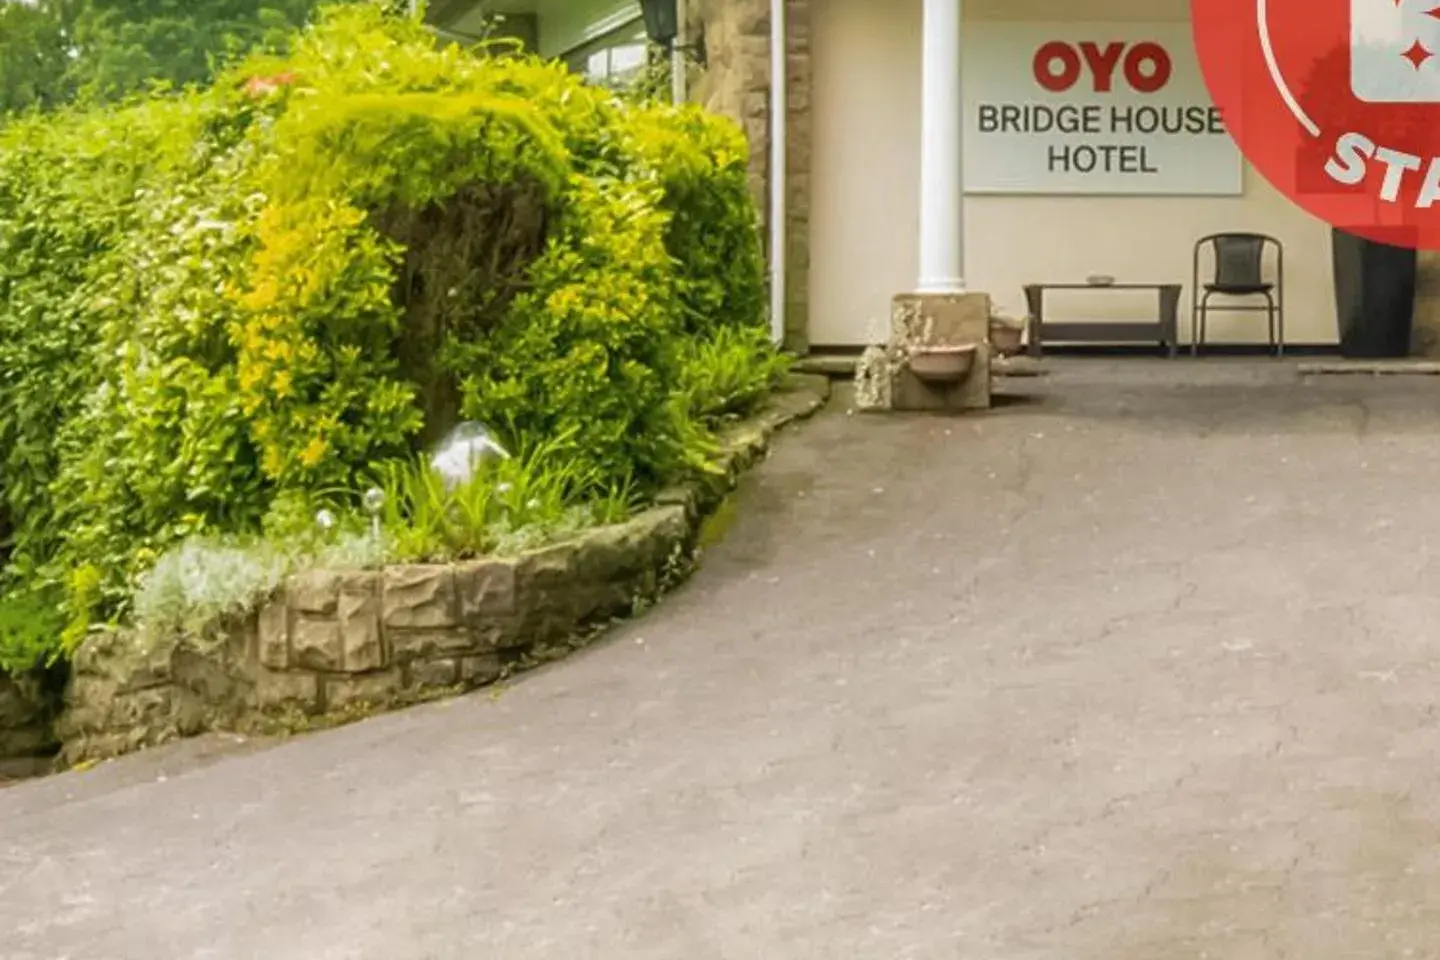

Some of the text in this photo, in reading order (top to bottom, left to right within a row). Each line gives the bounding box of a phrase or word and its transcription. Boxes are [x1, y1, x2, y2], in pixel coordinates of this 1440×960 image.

[1033, 41, 1172, 92] OYO
[978, 105, 1225, 134] BRIDGE HOUSE
[1048, 145, 1158, 172] HOTEL
